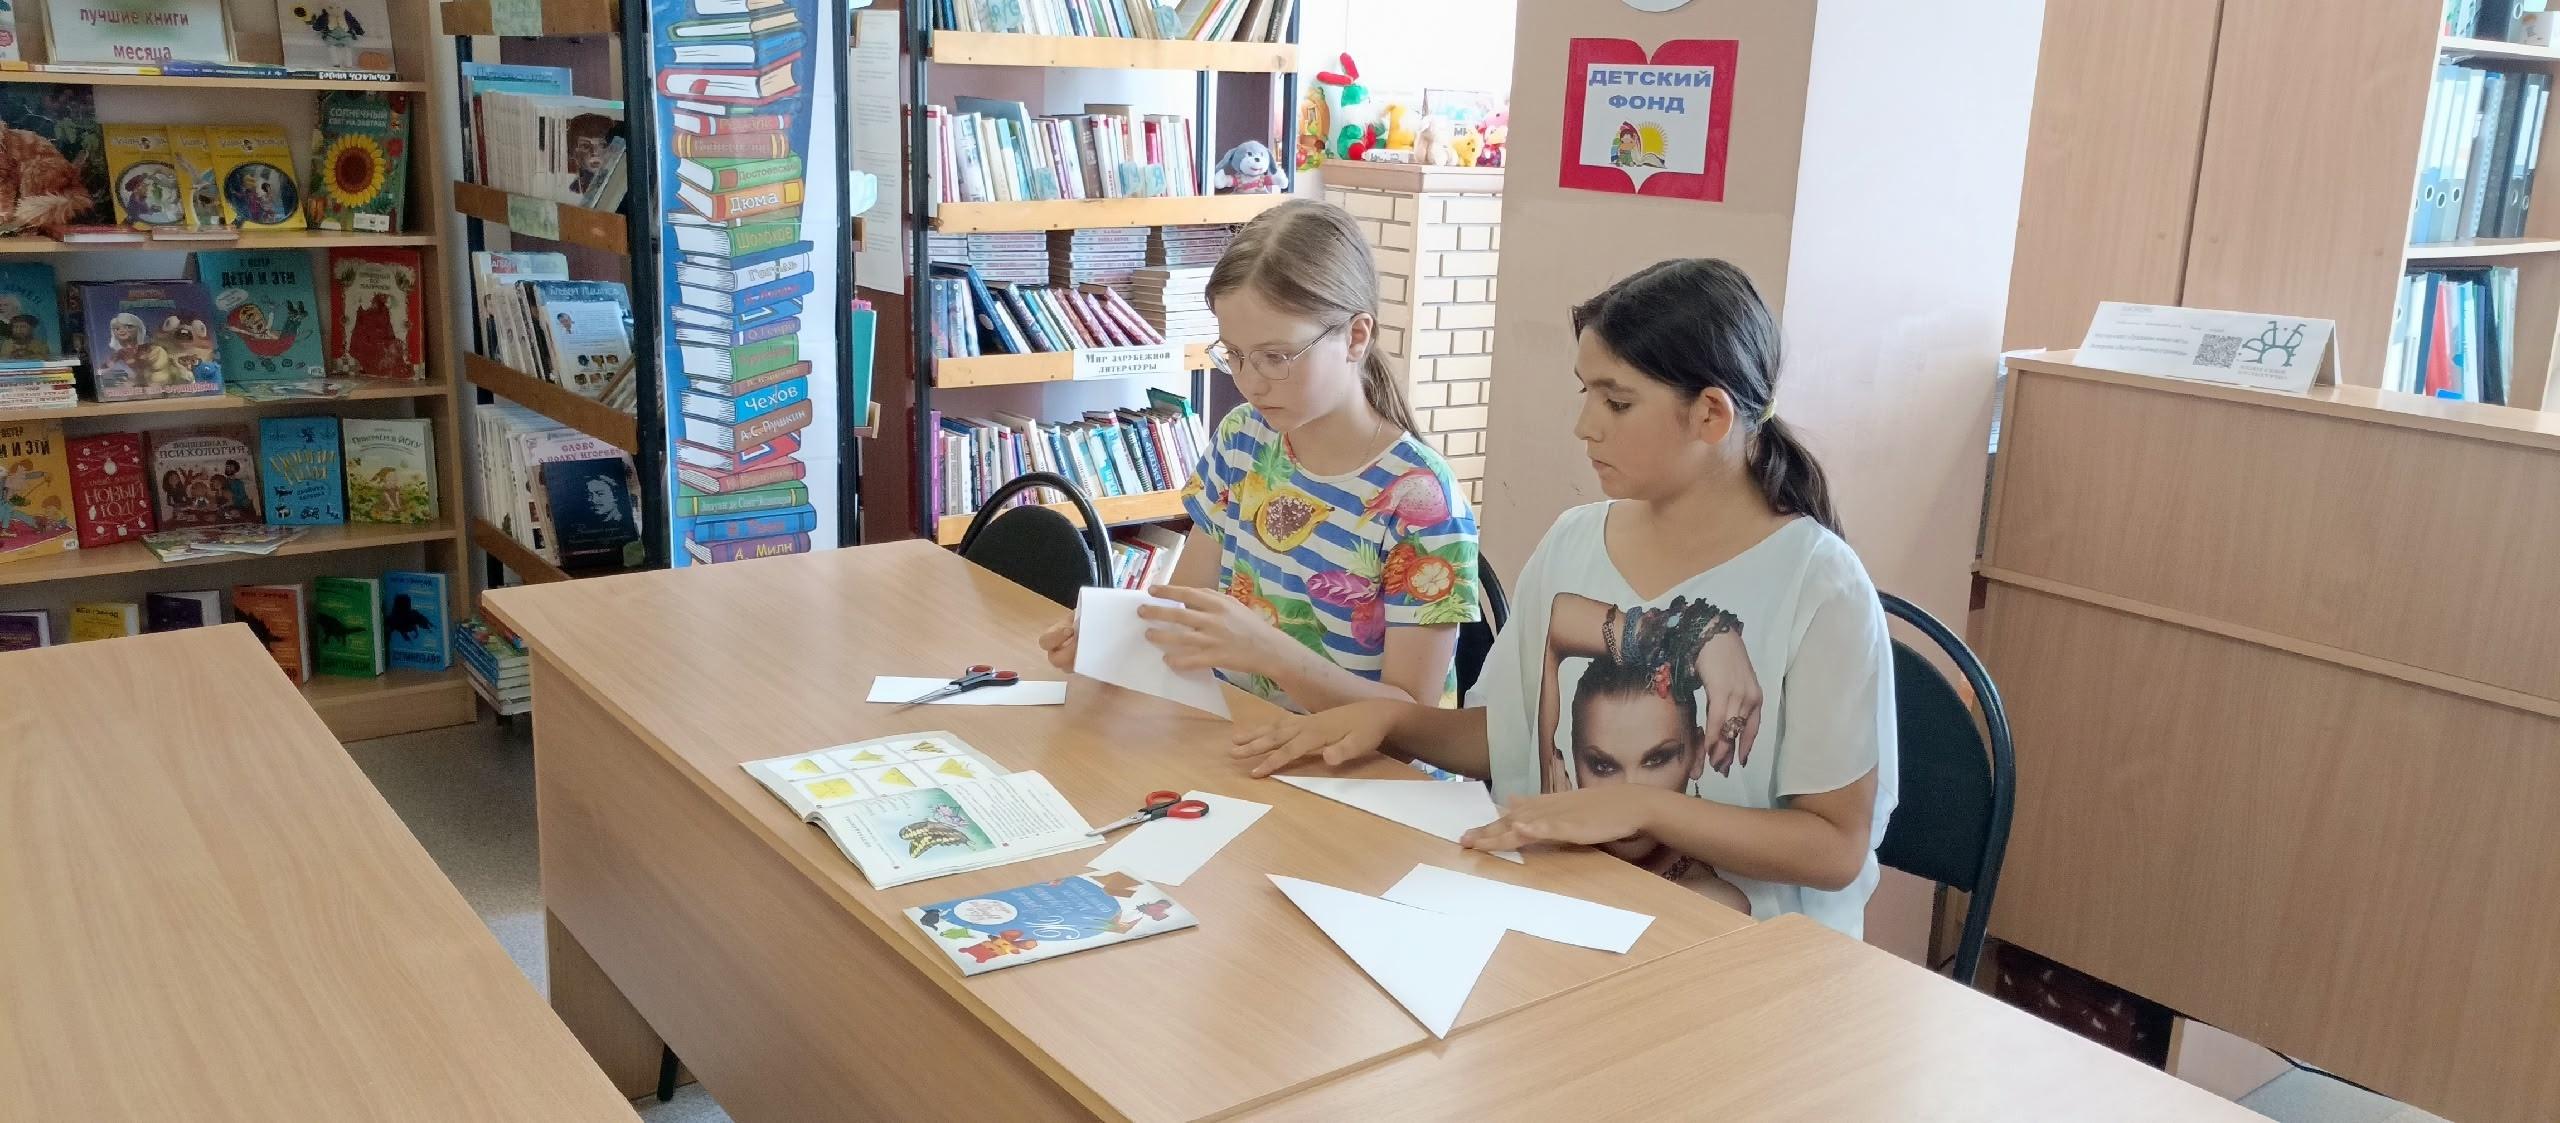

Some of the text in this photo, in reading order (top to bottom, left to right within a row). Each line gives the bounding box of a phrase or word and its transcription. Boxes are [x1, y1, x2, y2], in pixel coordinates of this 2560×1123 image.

[146, 11, 189, 26] книги
[113, 44, 172, 61] месяца
[1589, 70, 1712, 88] ДЕТСКИЙ
[1608, 94, 1685, 114] ФОНД
[730, 192, 780, 214] Дюма
[735, 226, 793, 249] Шолохов
[744, 386, 798, 412] Чехов
[160, 446, 245, 459] ПСИХОЛОГИЯ
[85, 481, 144, 505] НОВЫЙ
[756, 541, 793, 557] Милн
